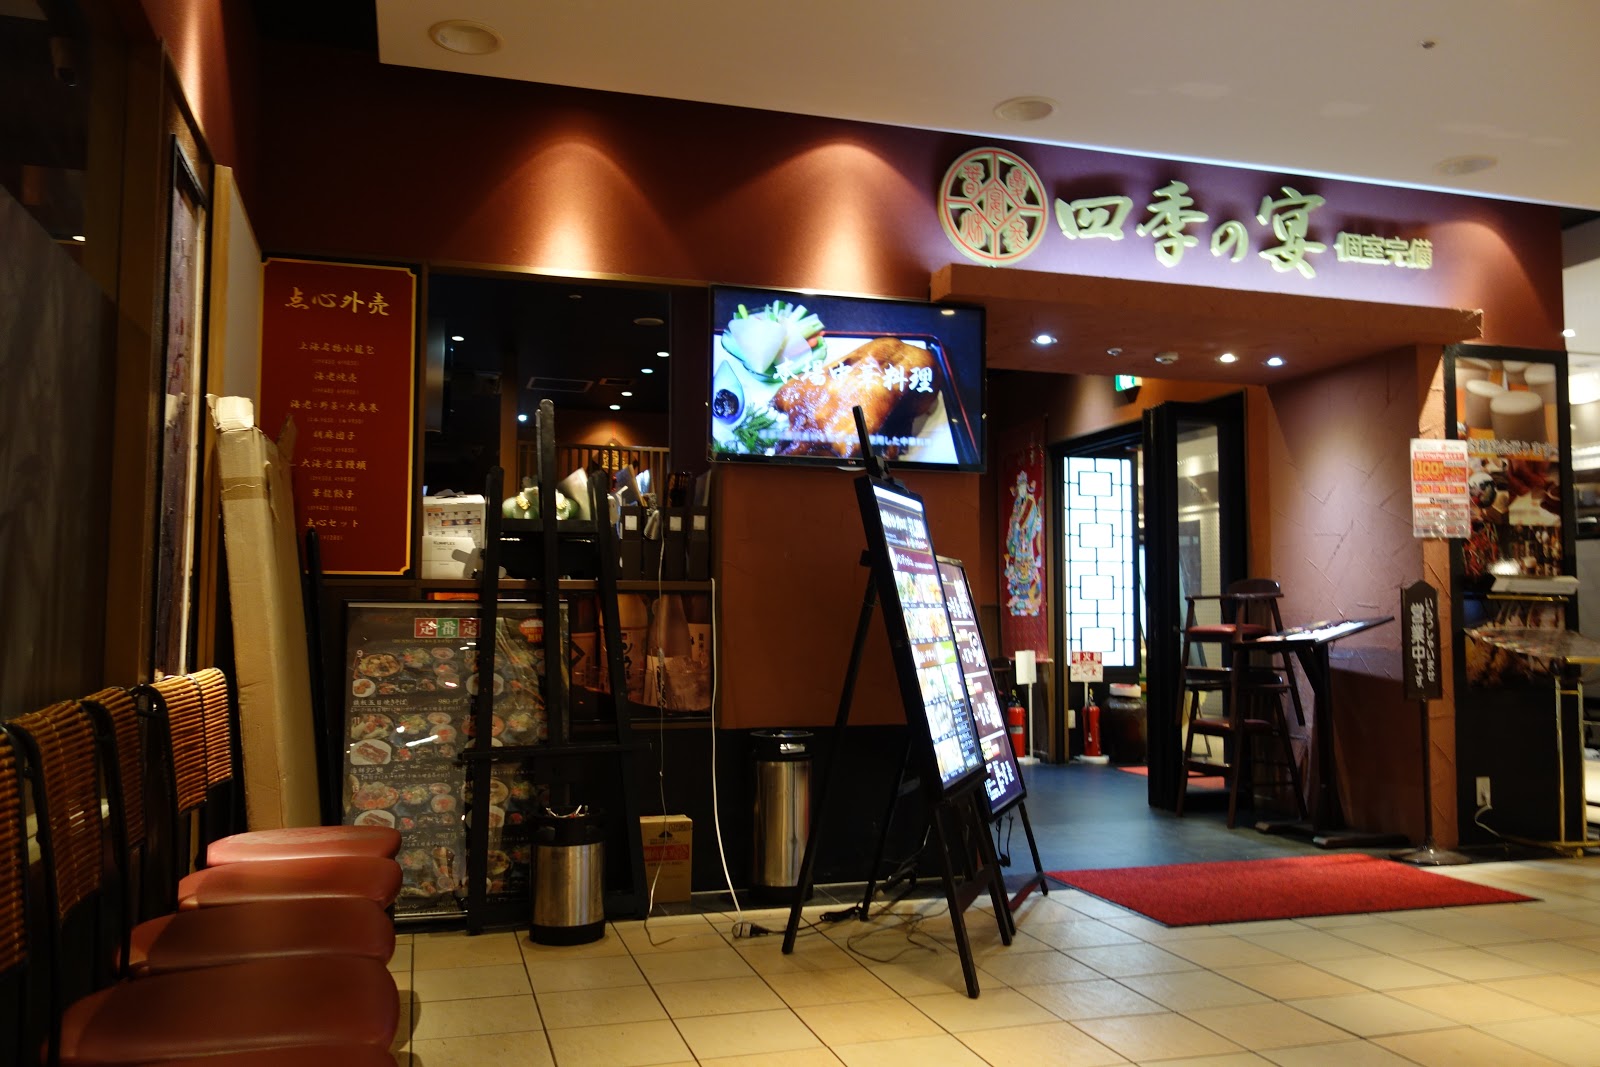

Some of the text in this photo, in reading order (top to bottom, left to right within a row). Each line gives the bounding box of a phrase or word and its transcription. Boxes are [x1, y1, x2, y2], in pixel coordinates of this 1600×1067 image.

[1054, 180, 1327, 279] 四季の宴
[1333, 231, 1434, 270] 個室完備
[284, 286, 390, 316] 点心外売
[772, 357, 934, 393] 本場中華料理
